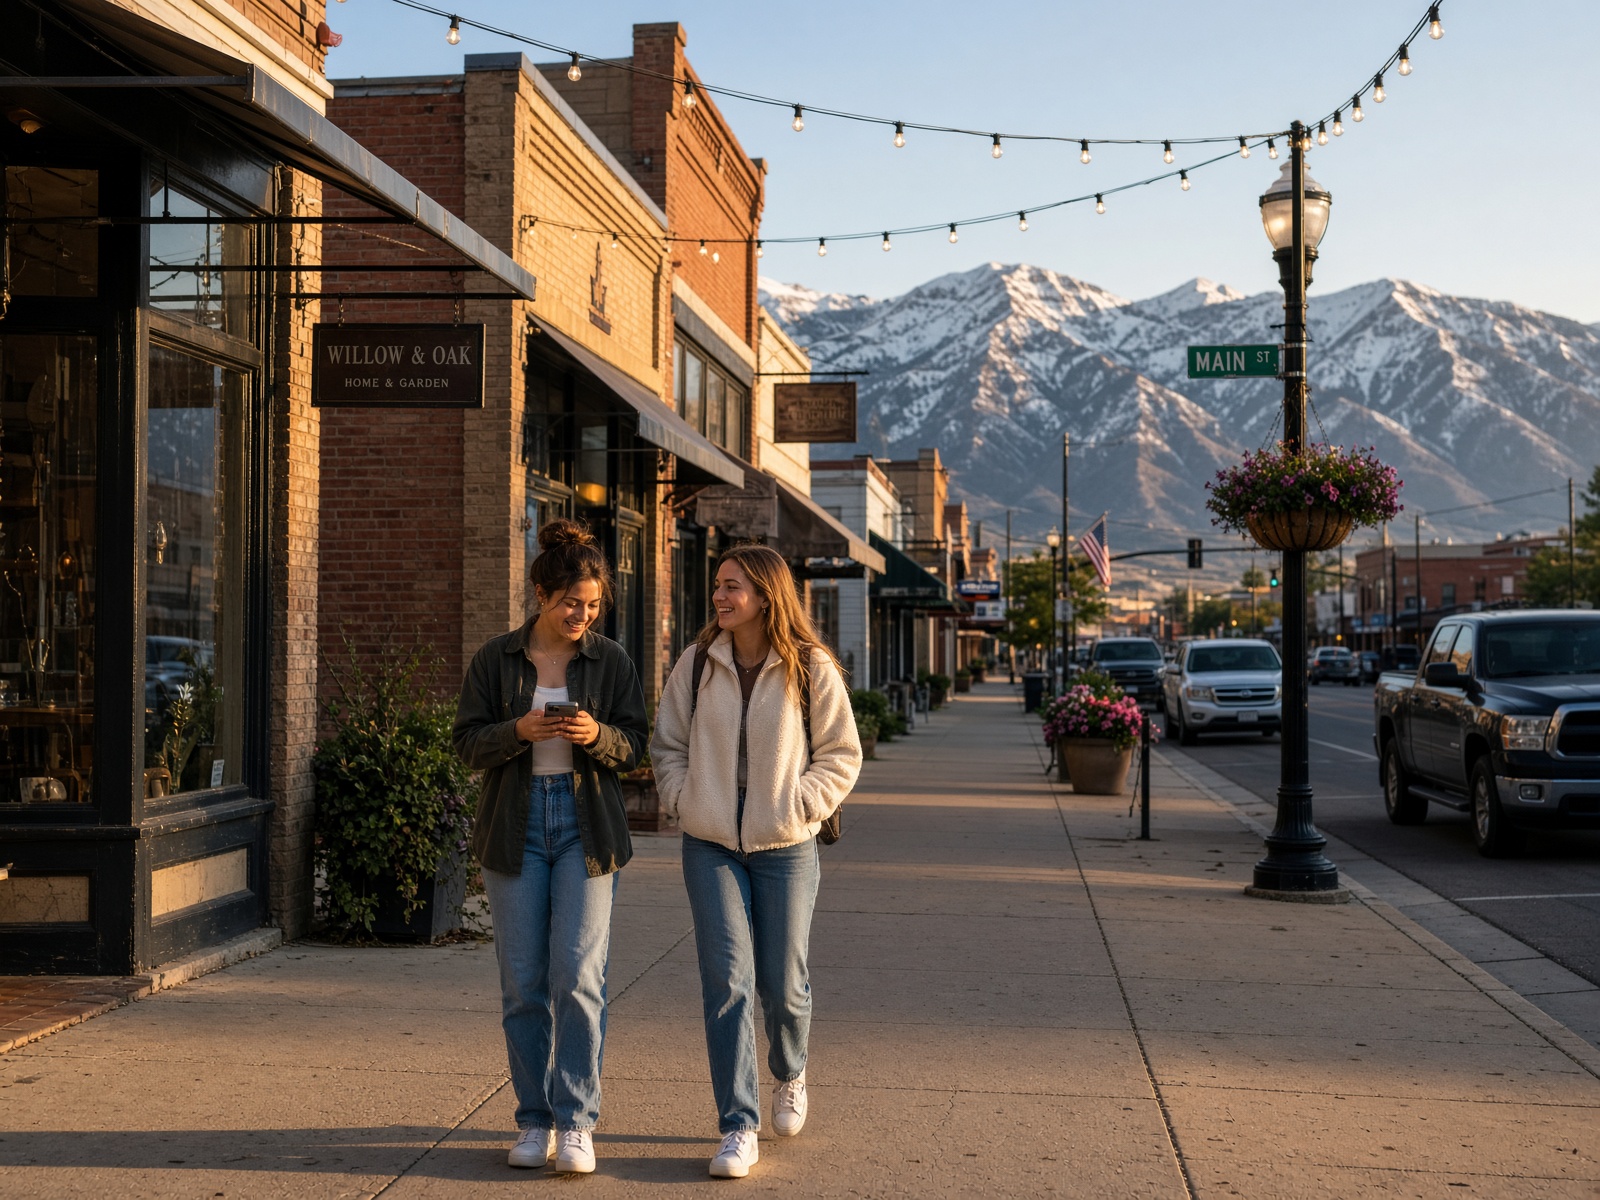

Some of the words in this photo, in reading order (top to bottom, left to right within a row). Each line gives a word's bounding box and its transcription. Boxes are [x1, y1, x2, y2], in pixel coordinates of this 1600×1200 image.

[327, 345, 404, 365] WILLOW
[411, 345, 426, 365] &
[432, 345, 472, 365] OAK
[1196, 351, 1245, 372] MAIN
[1256, 351, 1270, 363] ST
[345, 378, 379, 388] HOME
[385, 378, 394, 388] &
[399, 378, 449, 388] GARDEN
